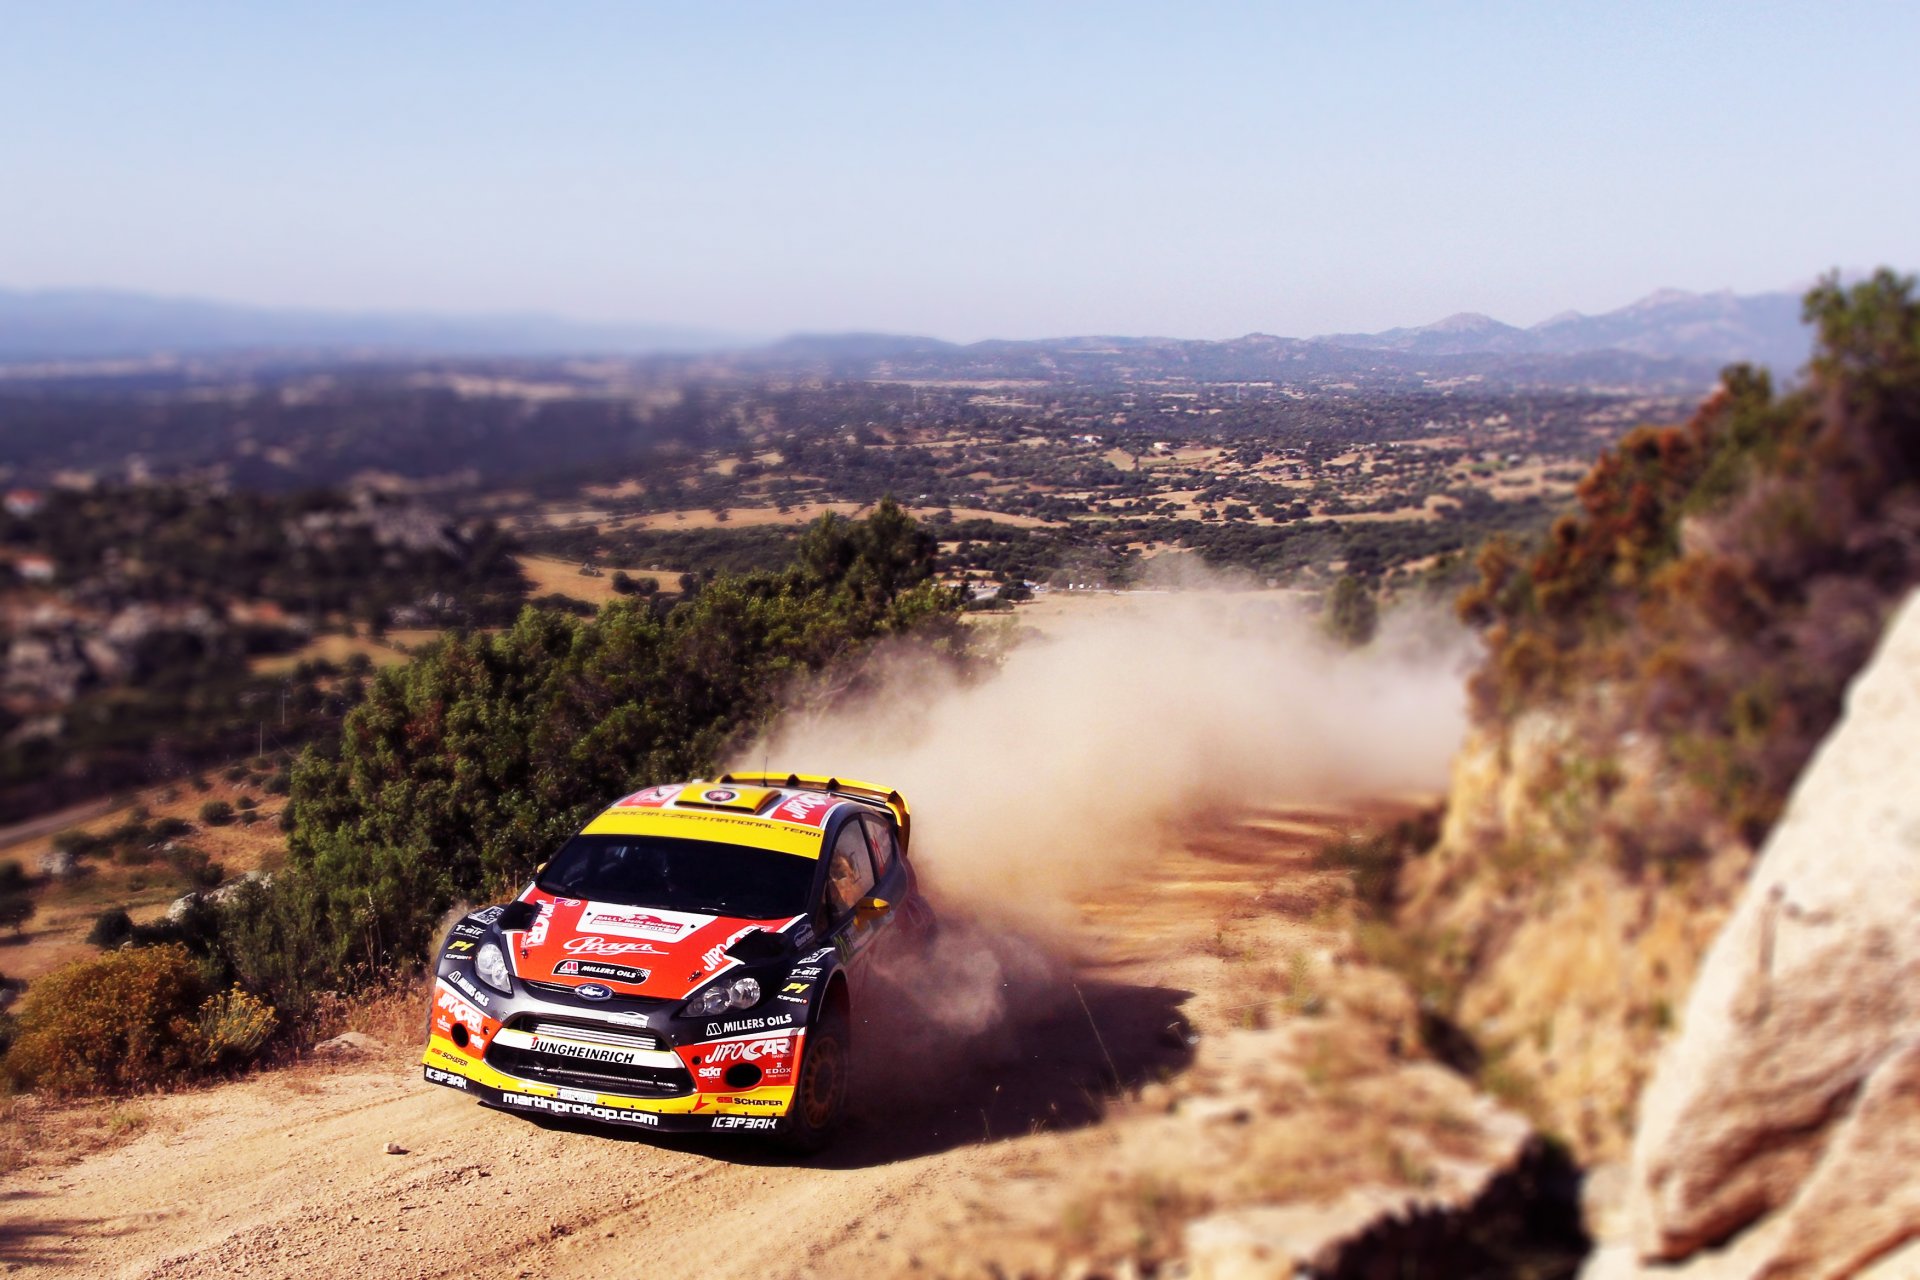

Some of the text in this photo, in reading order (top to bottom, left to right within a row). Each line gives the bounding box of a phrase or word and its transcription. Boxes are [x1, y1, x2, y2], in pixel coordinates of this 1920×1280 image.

[710, 817, 775, 830] NATIONAL
[782, 826, 821, 838] TEAM
[563, 936, 669, 956] Praga
[581, 965, 616, 975] MILLERS
[617, 969, 637, 978] OILS
[723, 1014, 793, 1033] MILLERS OILS
[531, 1040, 635, 1064] JUNGHEINRICH
[503, 1092, 659, 1126] martinprokop.com
